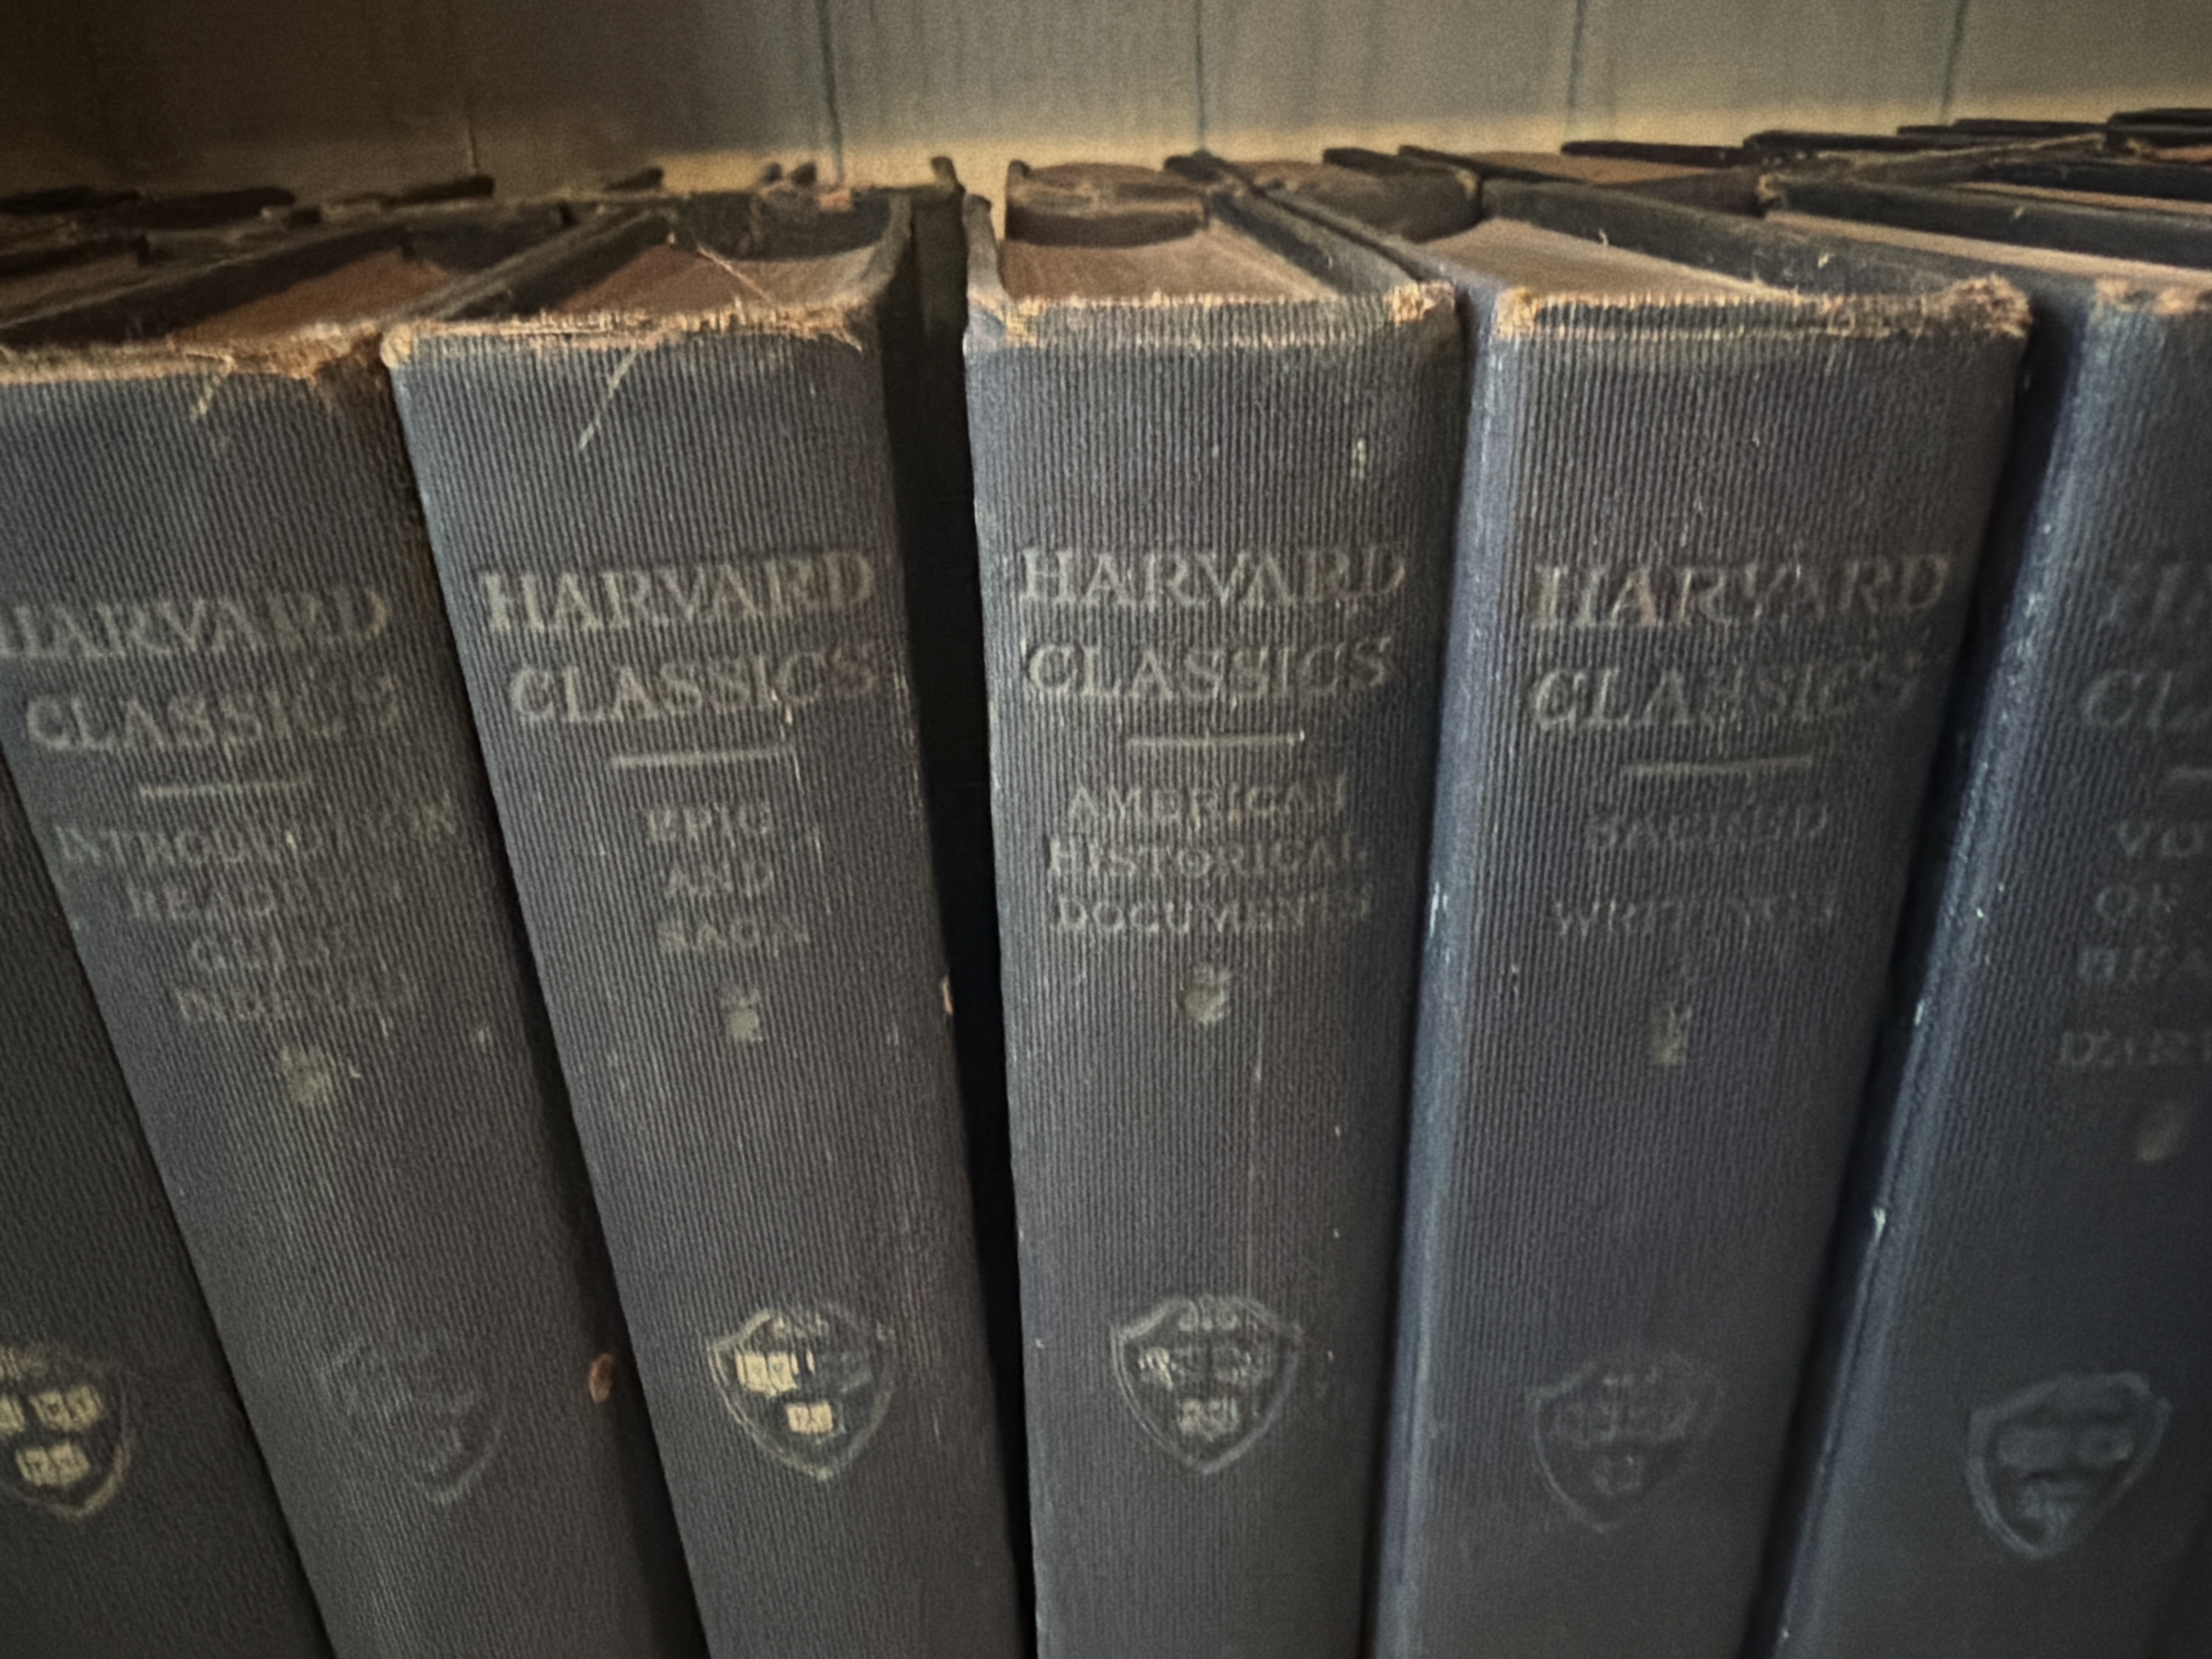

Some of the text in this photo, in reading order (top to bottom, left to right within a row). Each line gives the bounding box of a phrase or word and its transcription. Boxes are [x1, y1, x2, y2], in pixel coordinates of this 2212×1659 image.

[478, 551, 876, 632] HARVARD
[1019, 544, 1408, 610] HARVARD
[1532, 554, 1952, 629] HARVARD
[509, 641, 877, 723] CLASSICS
[1026, 634, 1392, 703] CLASSICS
[25, 672, 400, 752] CLASSICS
[1068, 772, 1347, 824] AMERICAN
